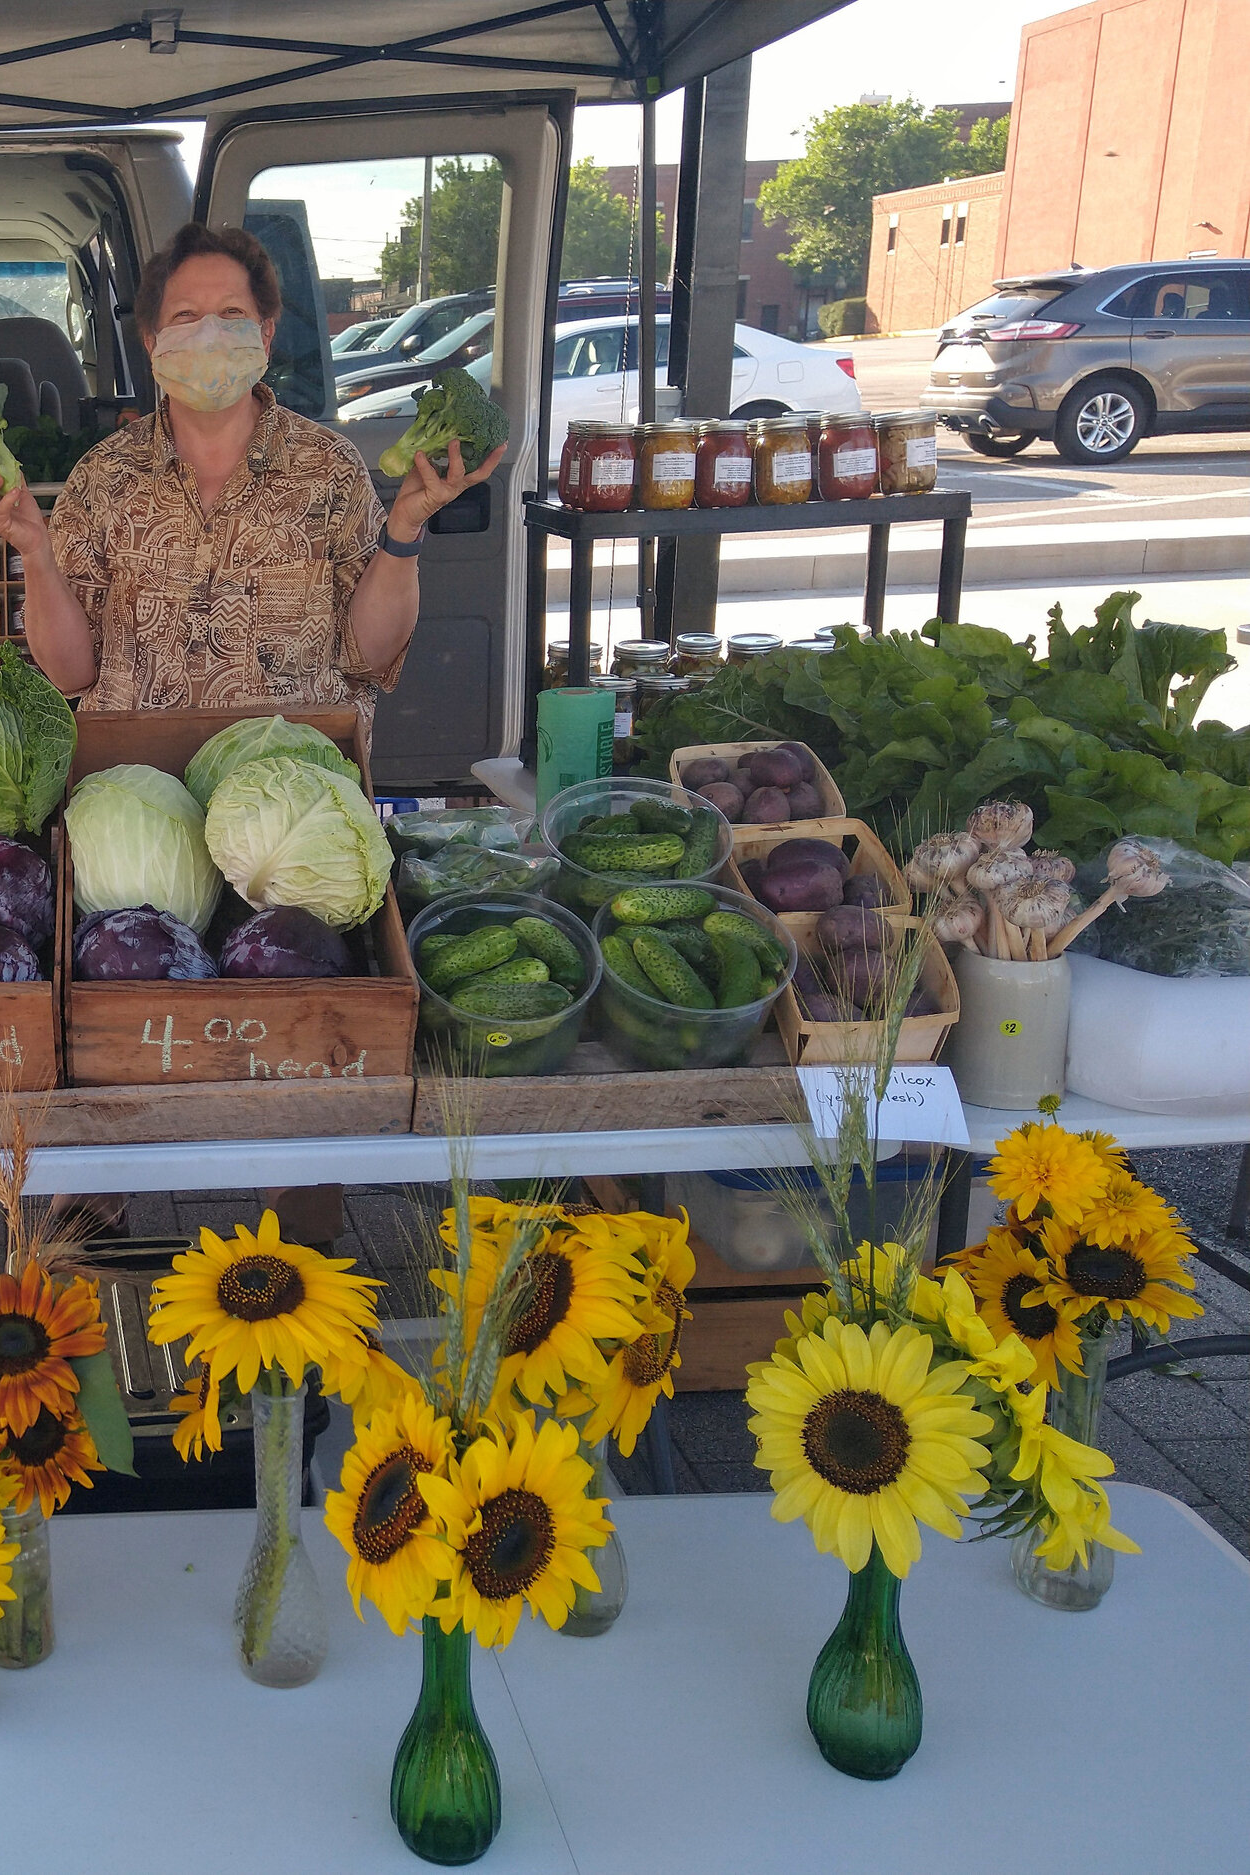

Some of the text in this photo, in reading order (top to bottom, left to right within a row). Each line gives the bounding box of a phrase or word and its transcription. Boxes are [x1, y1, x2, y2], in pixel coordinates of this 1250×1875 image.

[1005, 1023, 1016, 1033] $2
[250, 1050, 368, 1079] head
[891, 1070, 936, 1087] ilcox
[884, 1091, 924, 1107] lesh)
